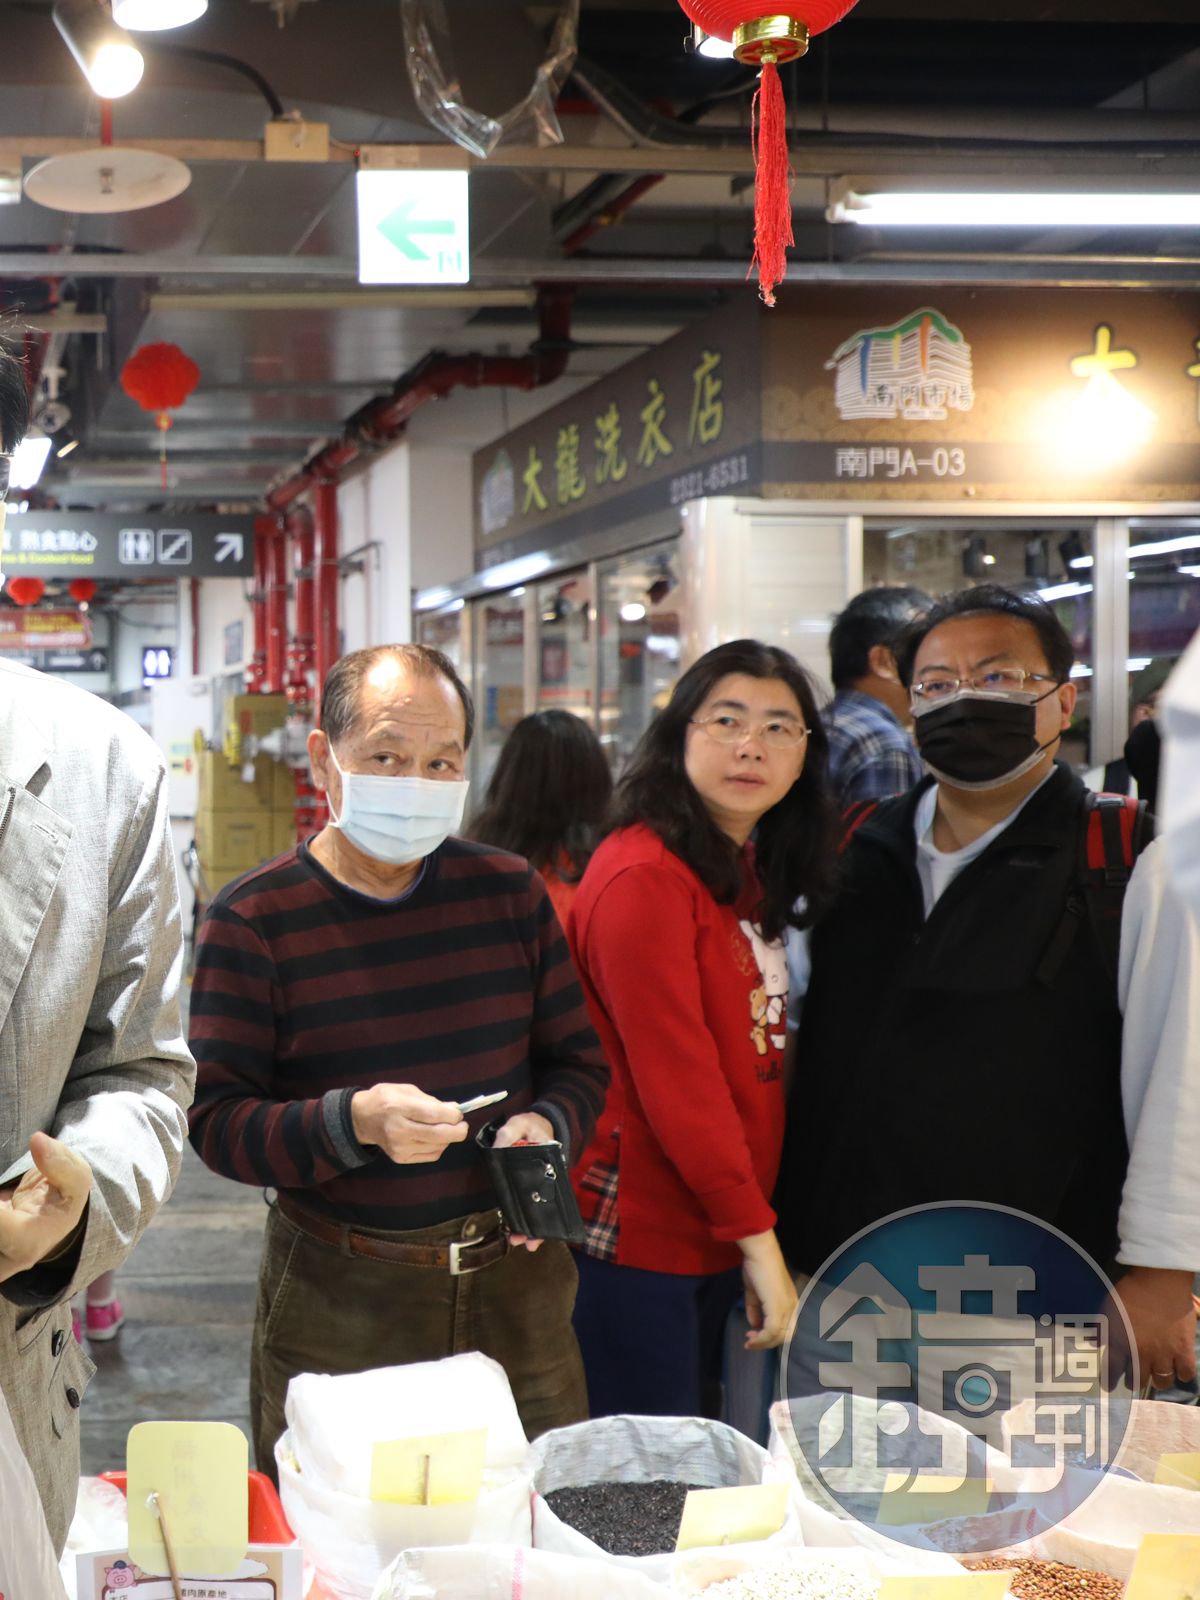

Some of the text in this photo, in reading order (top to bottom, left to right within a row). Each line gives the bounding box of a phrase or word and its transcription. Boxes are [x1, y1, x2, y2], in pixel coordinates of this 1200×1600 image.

[871, 384, 971, 410] 南門市場
[521, 351, 723, 514] 大龍洗衣店
[836, 447, 966, 477] 南門A-03
